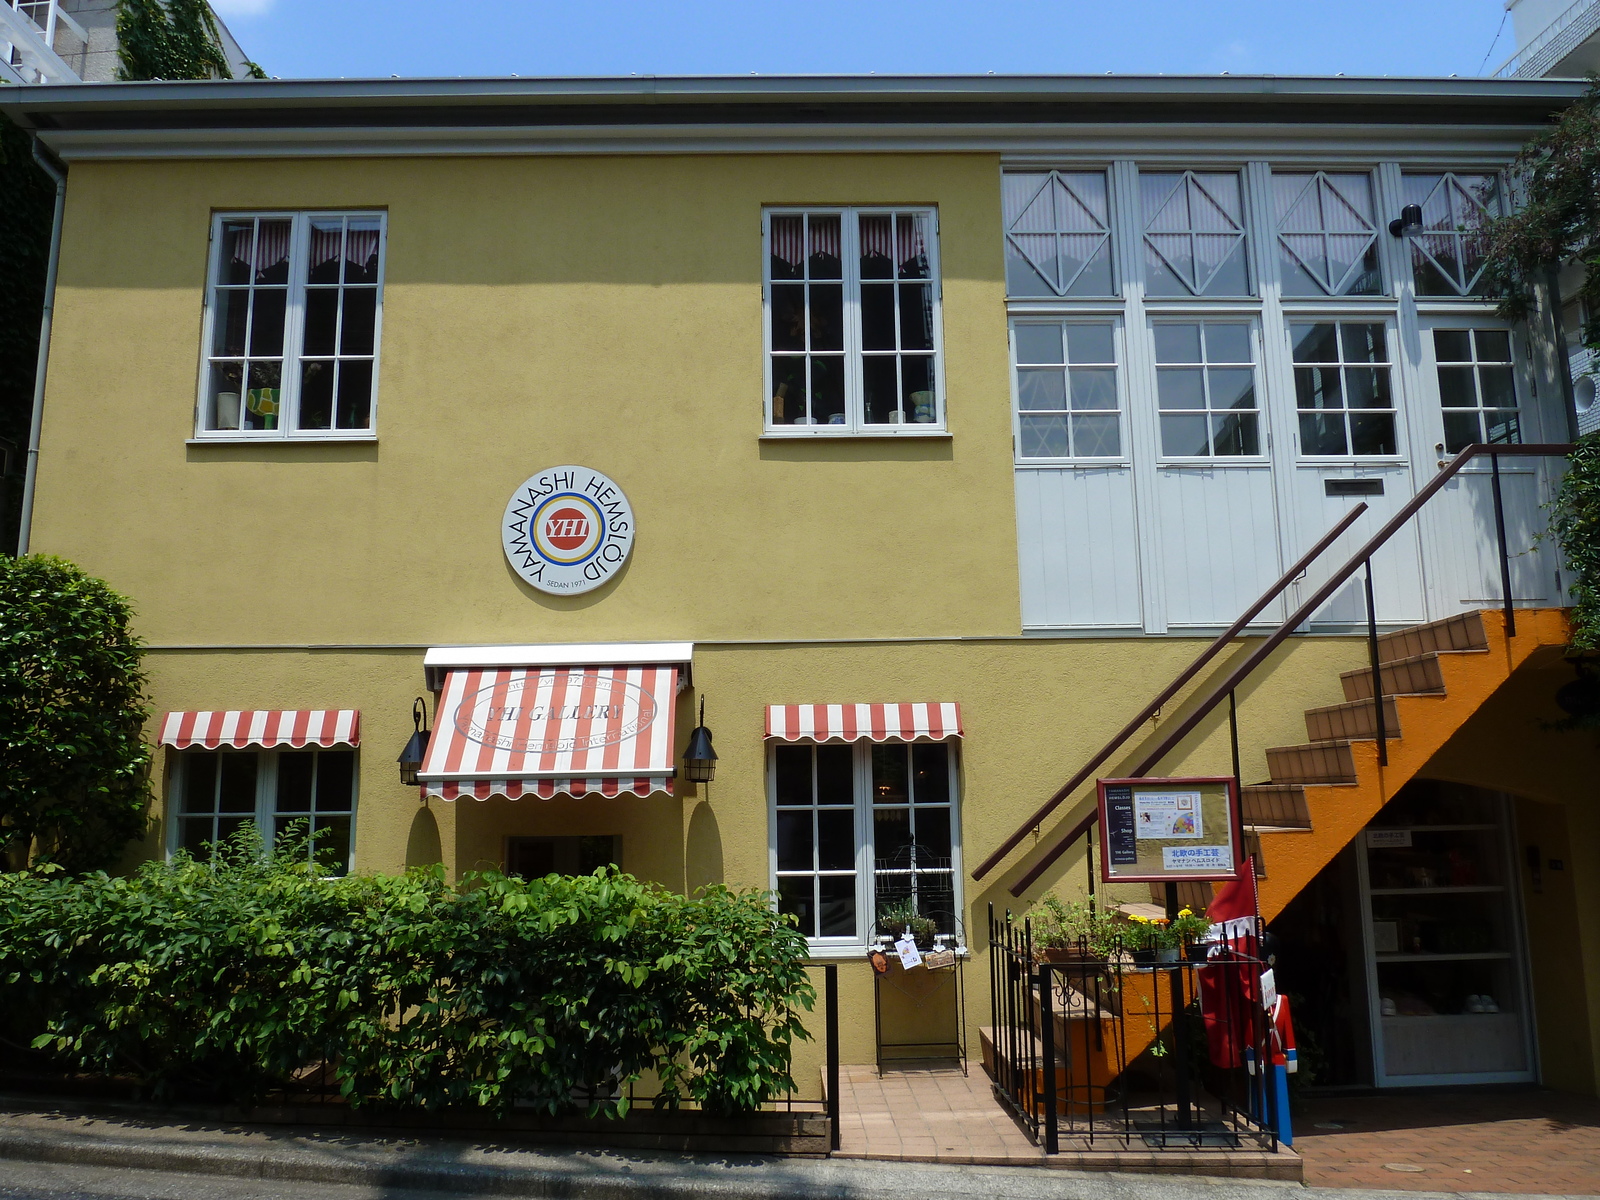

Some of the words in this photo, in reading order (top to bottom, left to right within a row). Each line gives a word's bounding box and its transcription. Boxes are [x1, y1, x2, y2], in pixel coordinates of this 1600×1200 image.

[509, 471, 574, 582] YAMANASHI
[583, 476, 629, 580] HEMSLÖJD
[547, 518, 588, 538] YHI
[546, 579, 570, 589] SEDAN
[571, 579, 587, 588] 1971
[487, 706, 523, 722] YHI
[529, 704, 626, 721] GALLERY
[459, 713, 513, 748] Yamanashi
[581, 709, 653, 747] International
[1171, 848, 1220, 858] 北欧の手工芸
